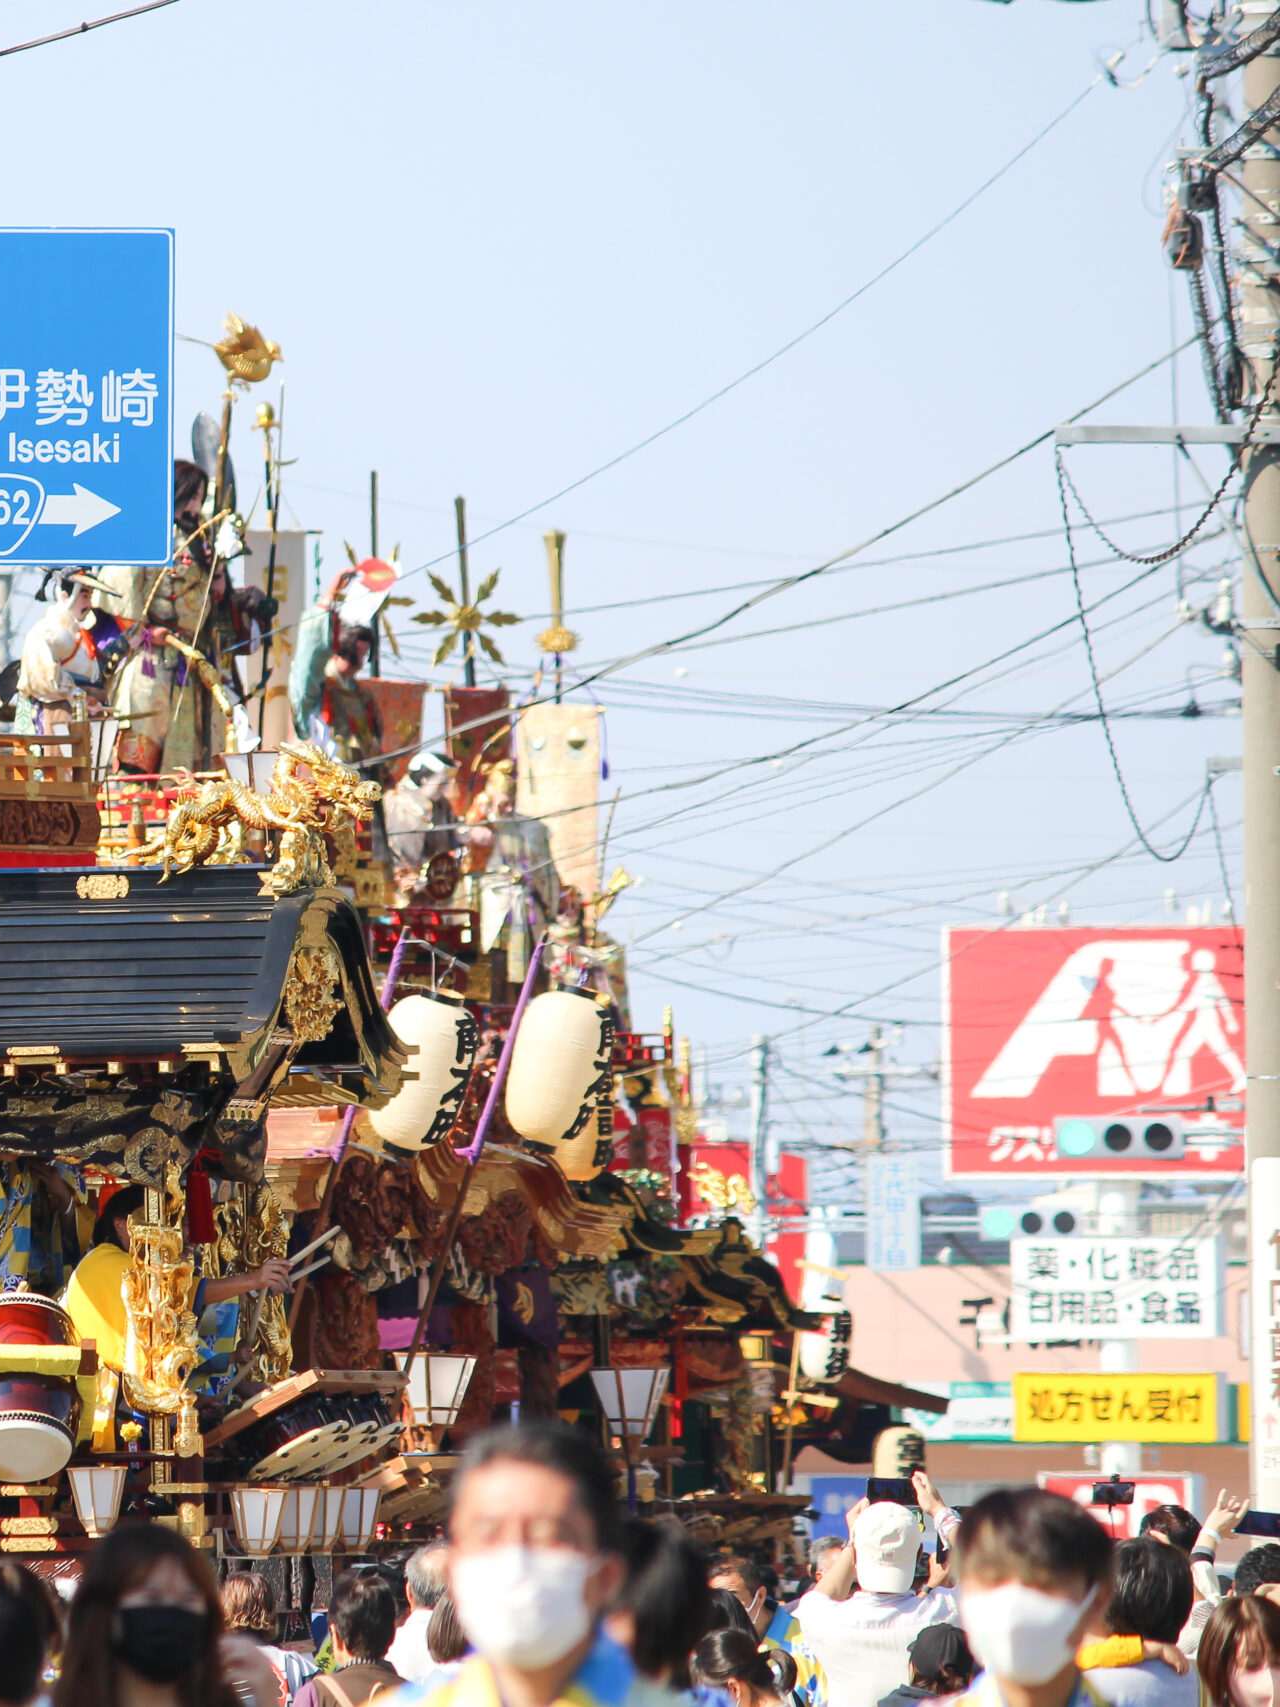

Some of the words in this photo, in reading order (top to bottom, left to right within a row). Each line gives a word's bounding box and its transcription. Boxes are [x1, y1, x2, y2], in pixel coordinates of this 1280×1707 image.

[8, 432, 120, 463] Isesaki
[1027, 1247, 1199, 1280] 薬・化粧品
[1029, 1291, 1201, 1324] 日用品・食品
[1029, 1388, 1201, 1422] 処方せん受付
